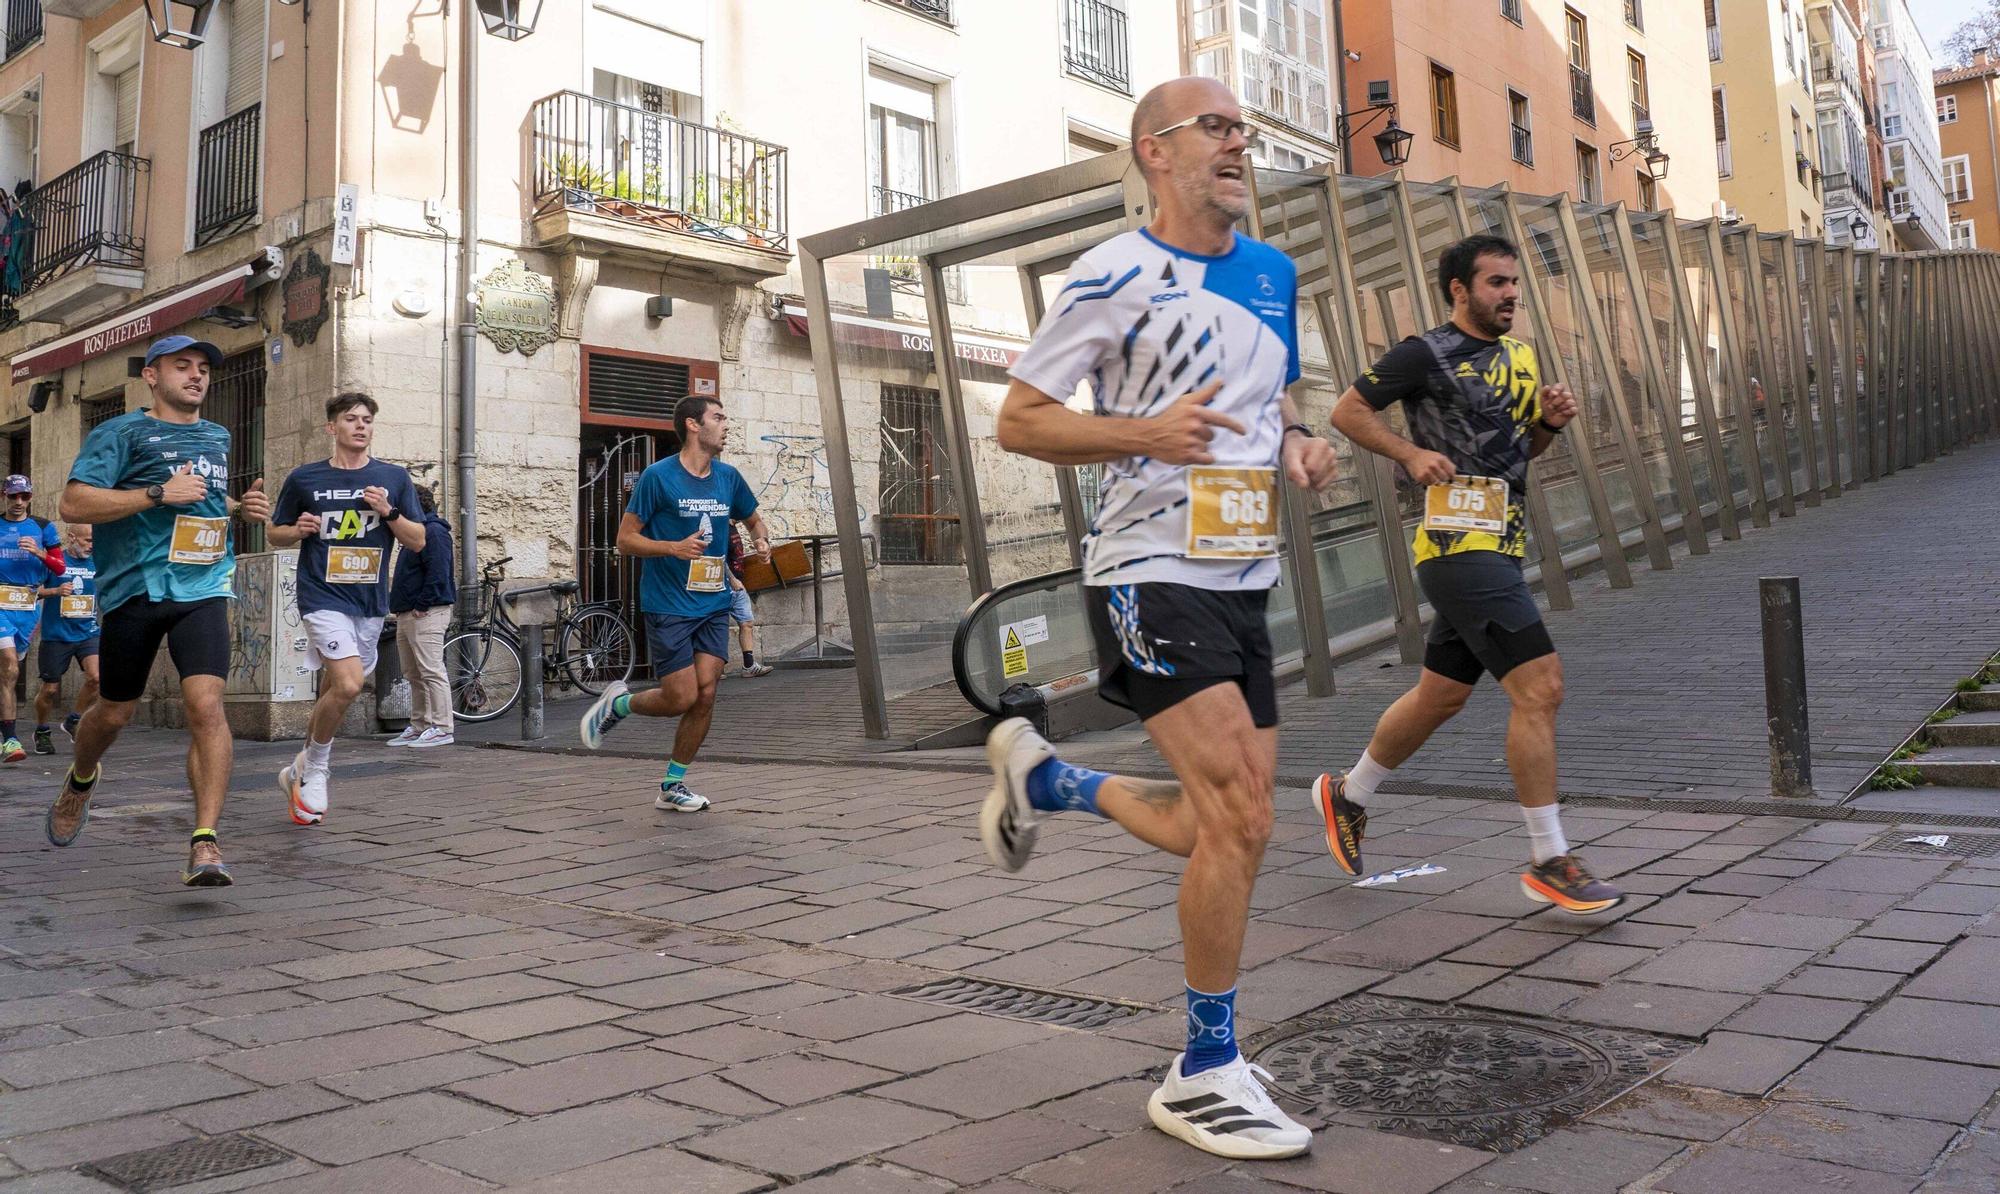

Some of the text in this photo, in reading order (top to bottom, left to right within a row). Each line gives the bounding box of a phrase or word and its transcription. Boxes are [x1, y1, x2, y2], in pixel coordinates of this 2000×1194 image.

[338, 197, 352, 252] BAR
[84, 316, 152, 355] ROSI JATETXEA
[1220, 490, 1269, 525] 683
[1448, 489, 1486, 512] 675
[193, 529, 221, 547] 401
[320, 509, 380, 540] CAP
[342, 556, 370, 570] 690
[705, 565, 721, 579] 119
[1336, 815, 1359, 858] KIPRUN
